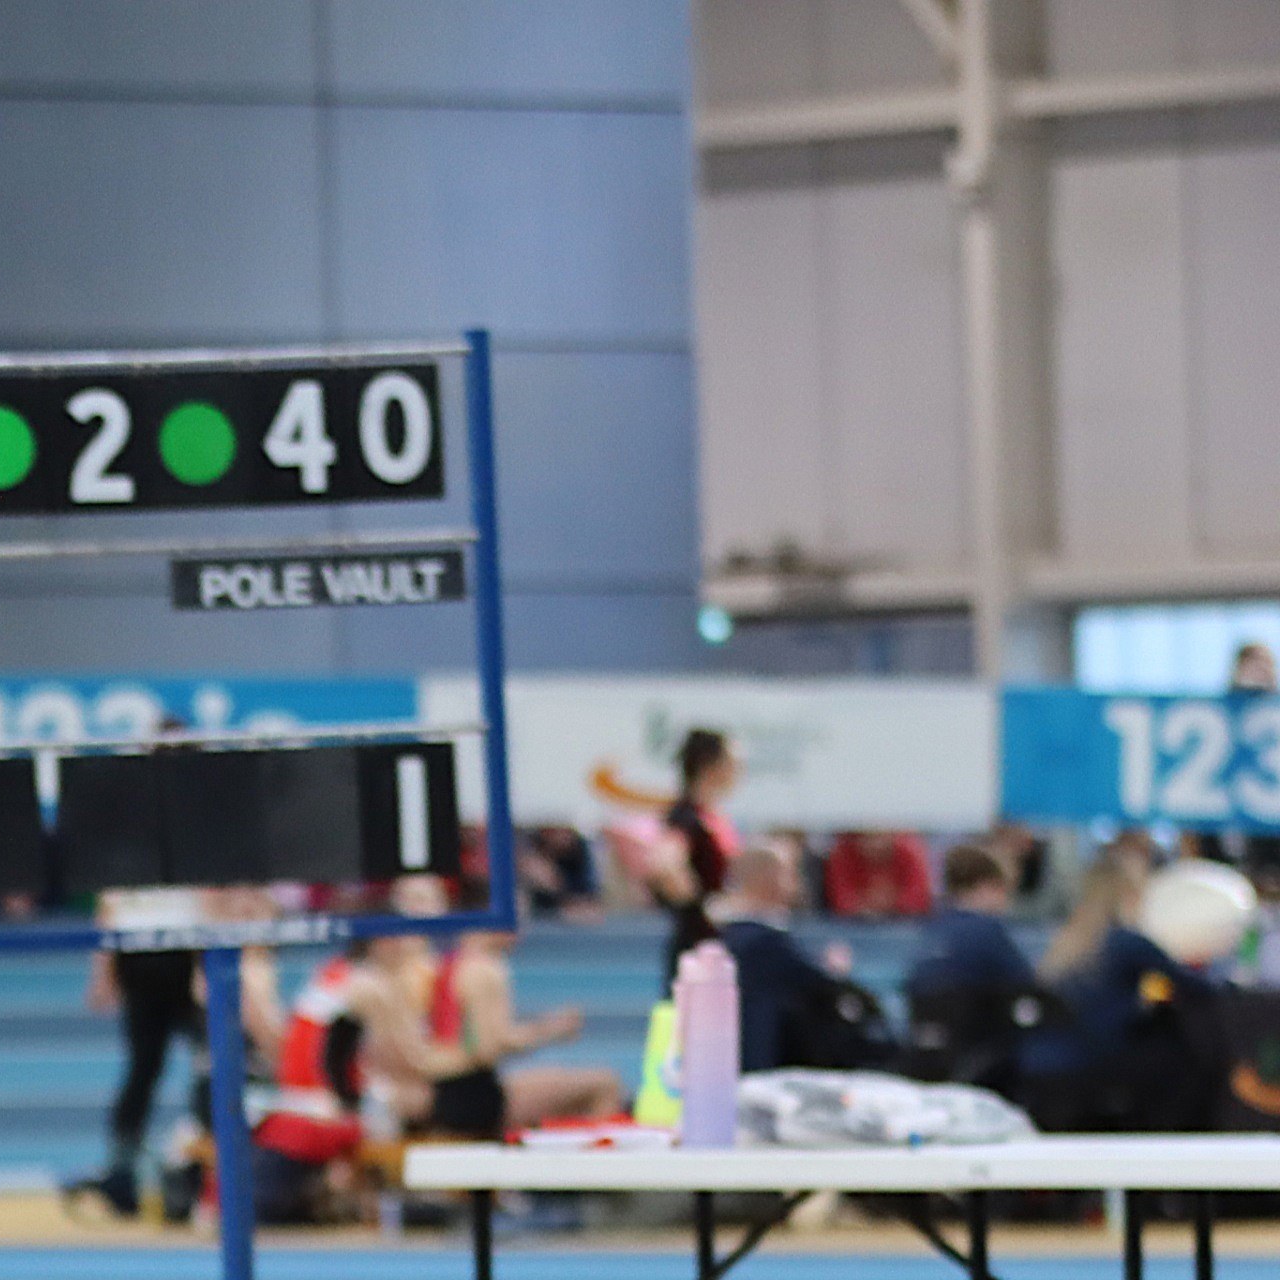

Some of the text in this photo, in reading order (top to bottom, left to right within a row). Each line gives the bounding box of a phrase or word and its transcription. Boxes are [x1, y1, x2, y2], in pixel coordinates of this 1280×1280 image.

[66, 388, 135, 503] 2
[200, 558, 445, 608] POLE VAULT
